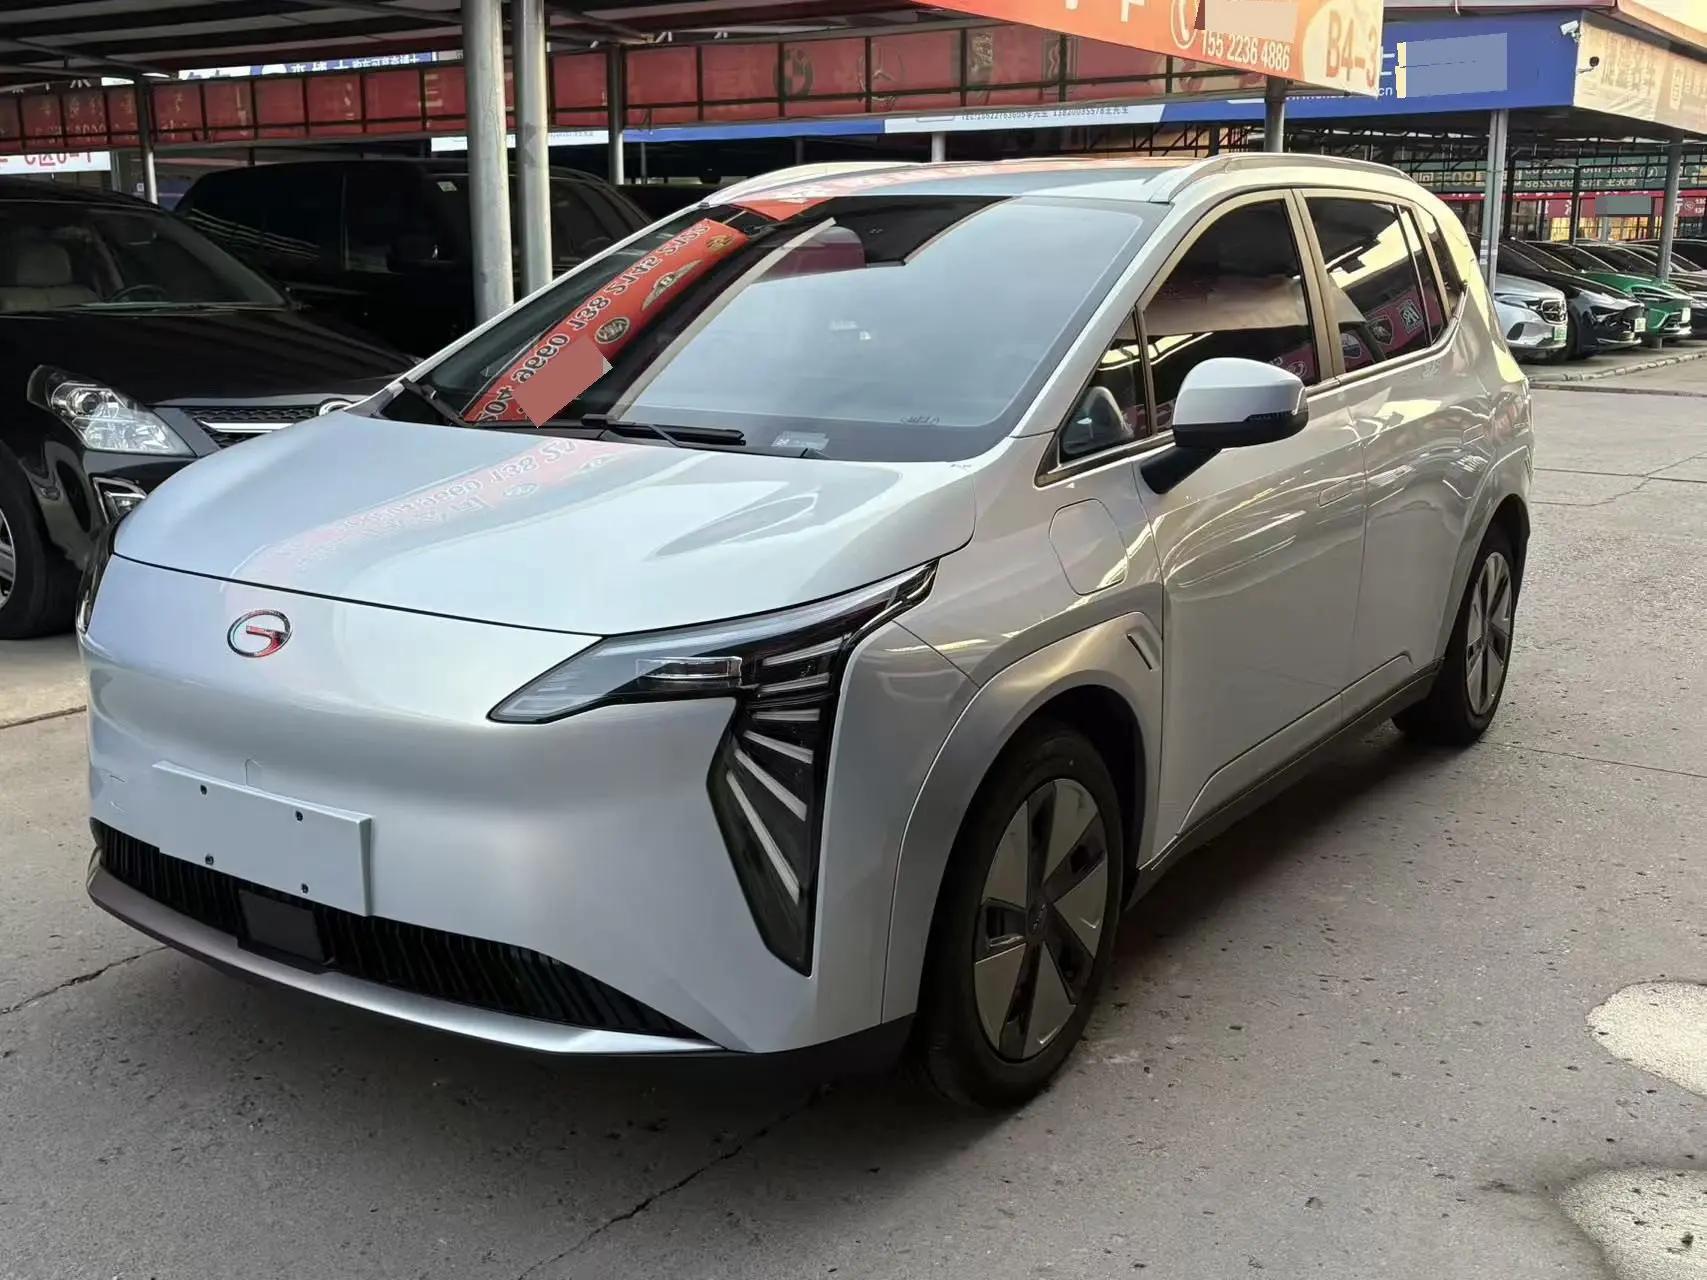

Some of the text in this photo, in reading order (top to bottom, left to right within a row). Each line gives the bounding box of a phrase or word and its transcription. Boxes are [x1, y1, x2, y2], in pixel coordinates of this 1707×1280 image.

[1201, 30, 1291, 72] 155 2236 4886
[1326, 10, 1379, 88] B4-3
